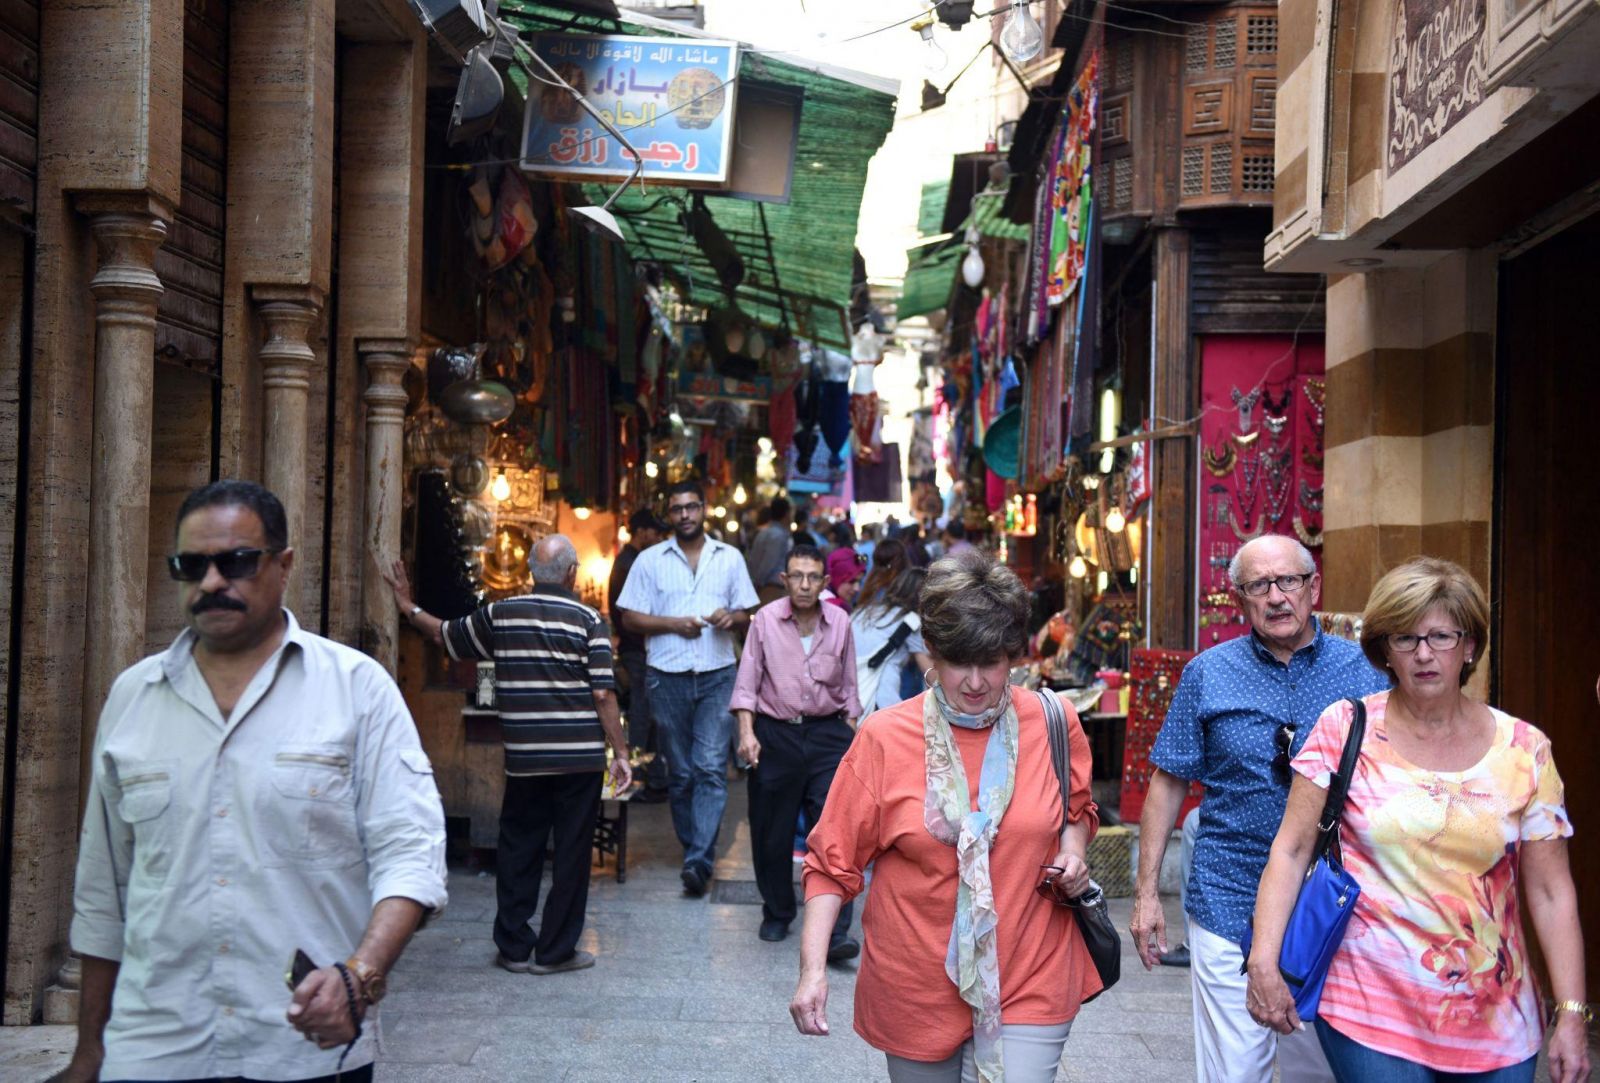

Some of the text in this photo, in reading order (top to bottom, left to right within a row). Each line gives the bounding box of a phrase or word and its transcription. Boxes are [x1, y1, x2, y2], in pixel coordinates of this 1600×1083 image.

[650, 47, 673, 64] الله
[677, 48, 719, 65] ماشاء
[592, 65, 668, 98] بازار
[549, 127, 607, 164] رزق
